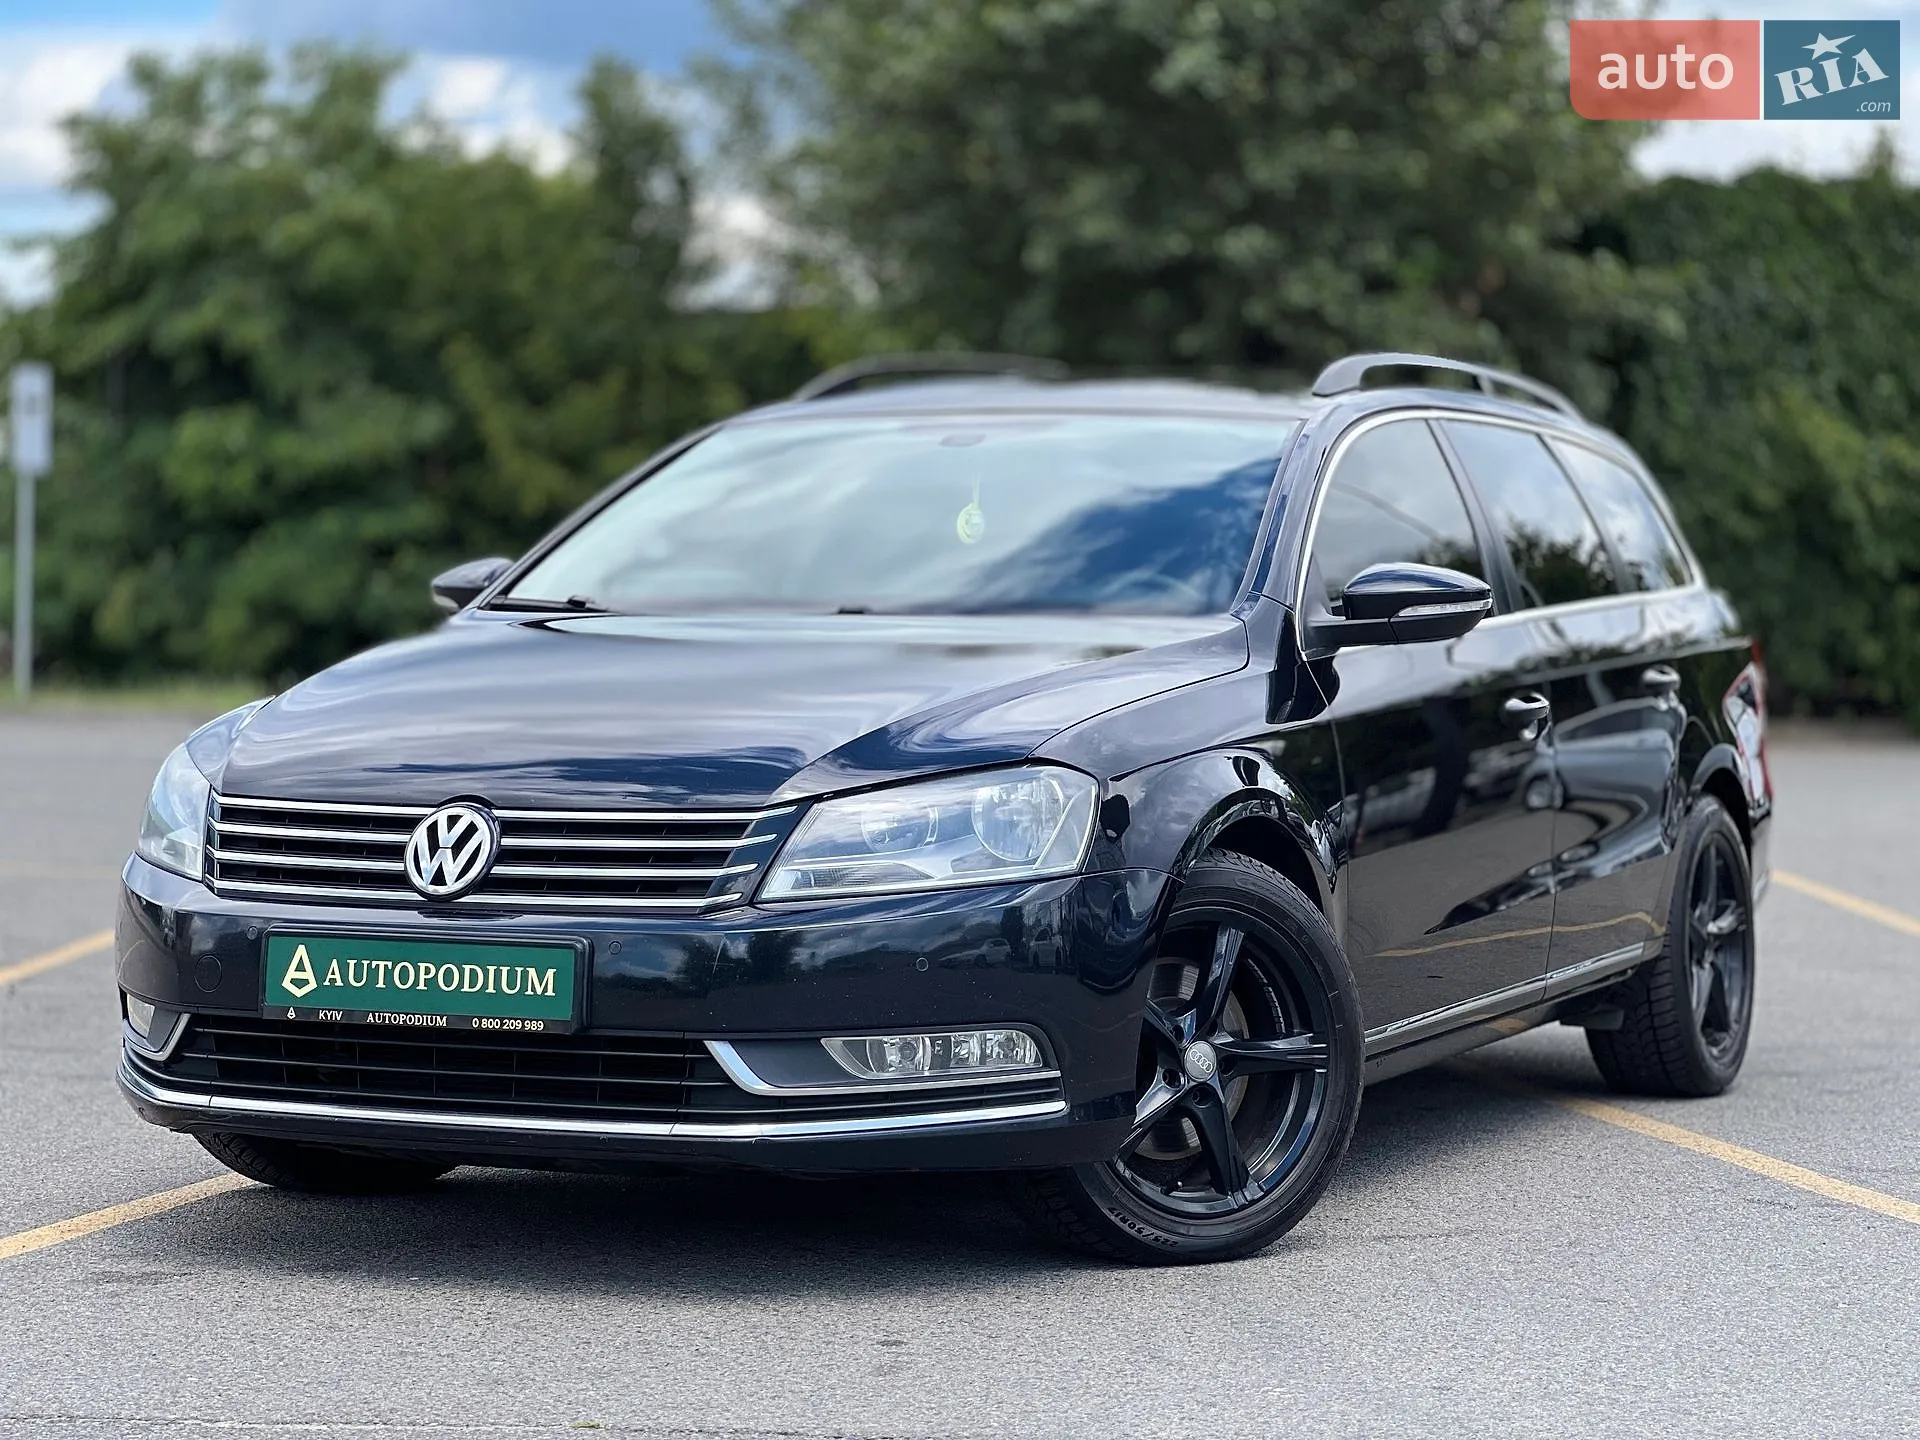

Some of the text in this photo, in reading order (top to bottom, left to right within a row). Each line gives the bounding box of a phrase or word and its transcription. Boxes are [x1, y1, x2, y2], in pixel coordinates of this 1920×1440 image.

[406, 806, 491, 895] VW
[323, 958, 557, 997] AUTOPODIUM
[318, 1010, 545, 1032] KYIV AUTOPODIUM 0 800 209 989
[1107, 1206, 1178, 1248] 225/50R17
